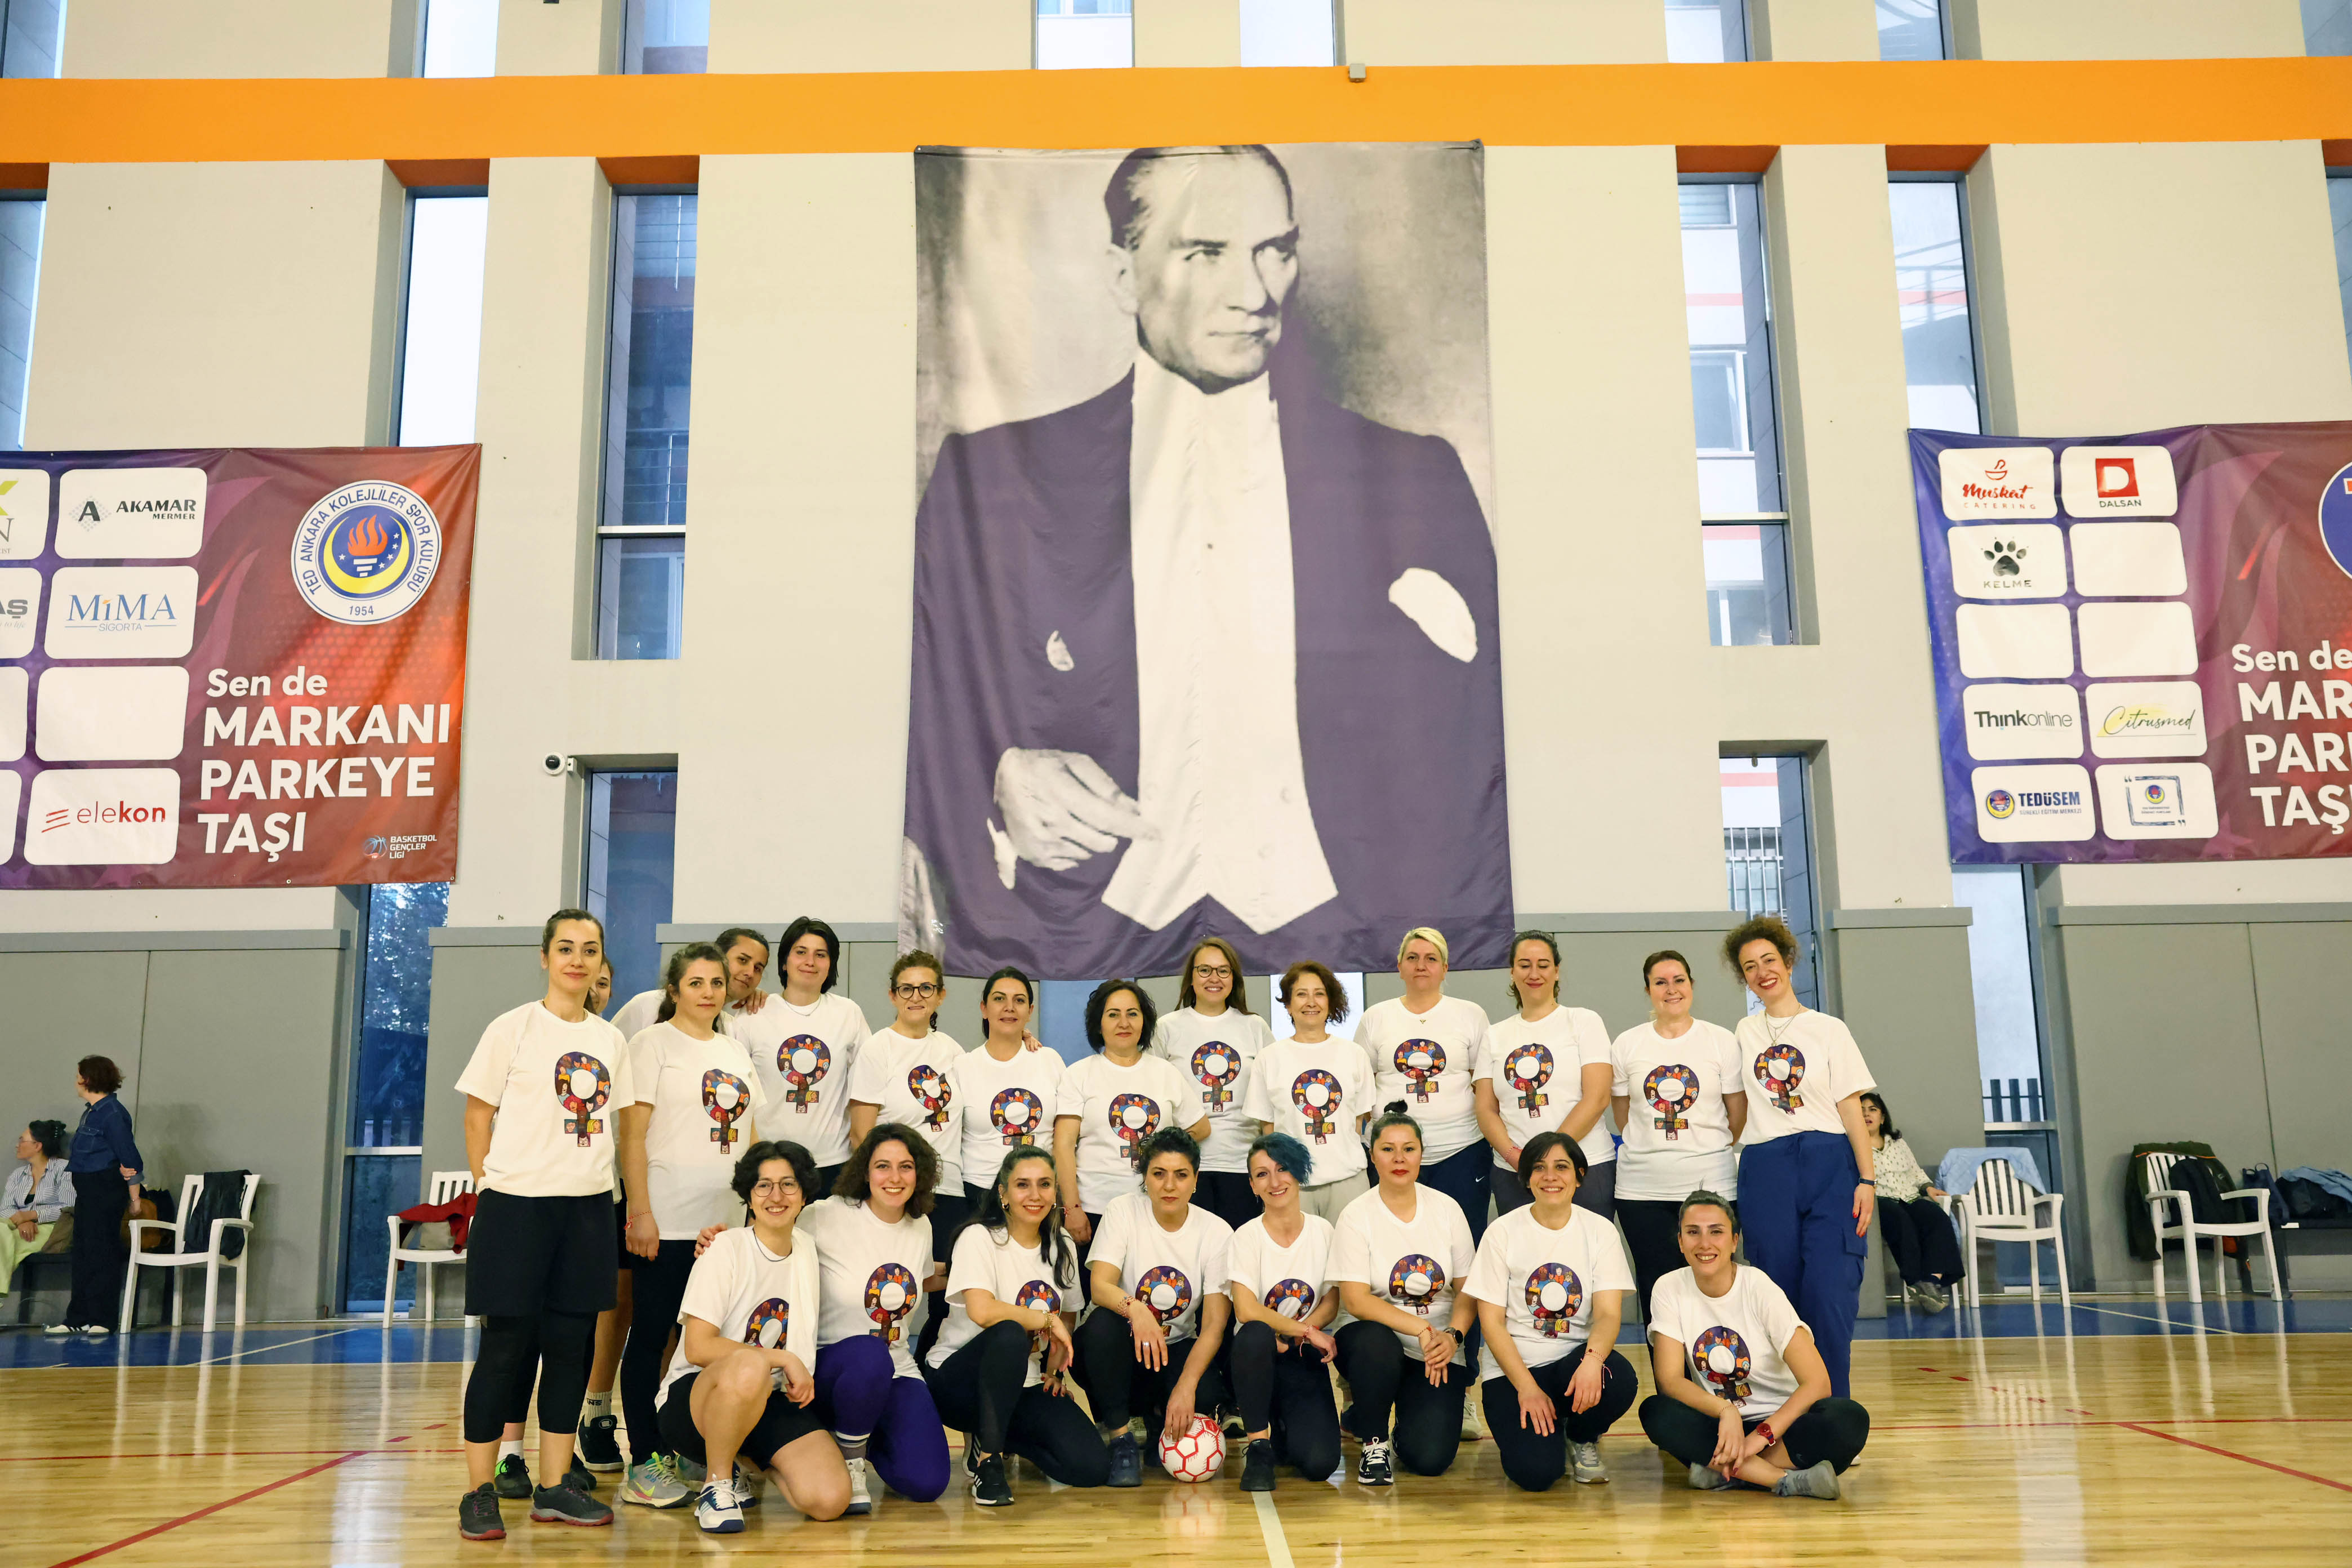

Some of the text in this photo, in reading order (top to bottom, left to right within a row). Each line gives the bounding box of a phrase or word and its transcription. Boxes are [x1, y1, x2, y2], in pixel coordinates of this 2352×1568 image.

[1963, 483, 2033, 500] Muskat
[116, 500, 196, 513] AKAMAR
[300, 486, 434, 595] TED ANKARA KOLEJLİLER SPOR KULÜBÜ
[349, 605, 374, 616] 1954
[2231, 640, 2352, 672] Sen de
[206, 666, 328, 697] Sen de
[203, 703, 450, 746] MARKANI
[2104, 706, 2195, 734] Citrusmed
[2245, 732, 2352, 774] PAR
[201, 756, 435, 800] PARKEYE
[77, 800, 166, 823] elekon
[198, 812, 306, 862] TAŞI
[390, 835, 437, 843] BASKETBOL
[390, 843, 426, 852] GENÇLER
